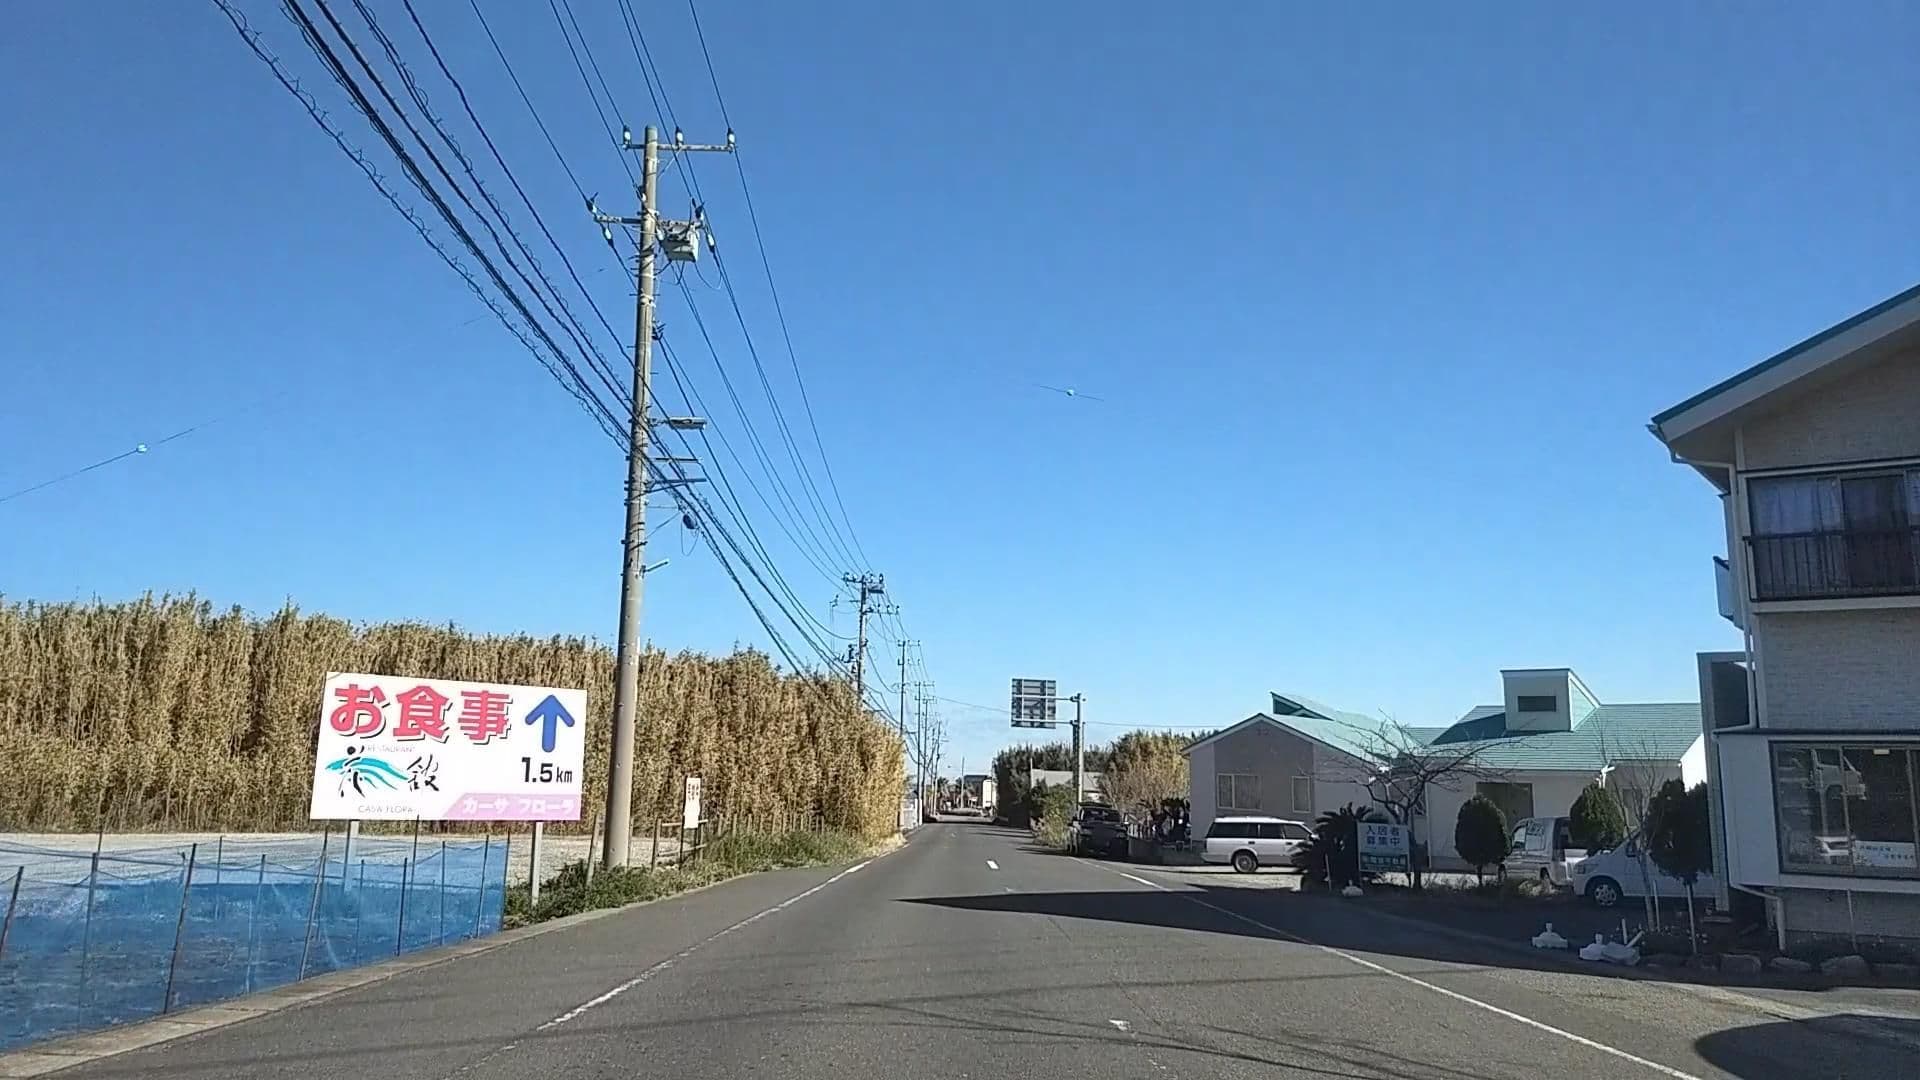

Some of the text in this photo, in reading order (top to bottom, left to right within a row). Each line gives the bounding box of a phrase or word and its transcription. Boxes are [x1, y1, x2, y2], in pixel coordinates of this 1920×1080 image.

[330, 683, 512, 744] お食事
[367, 743, 416, 753] RETAURAN
[462, 797, 576, 816] カーサ フローラ
